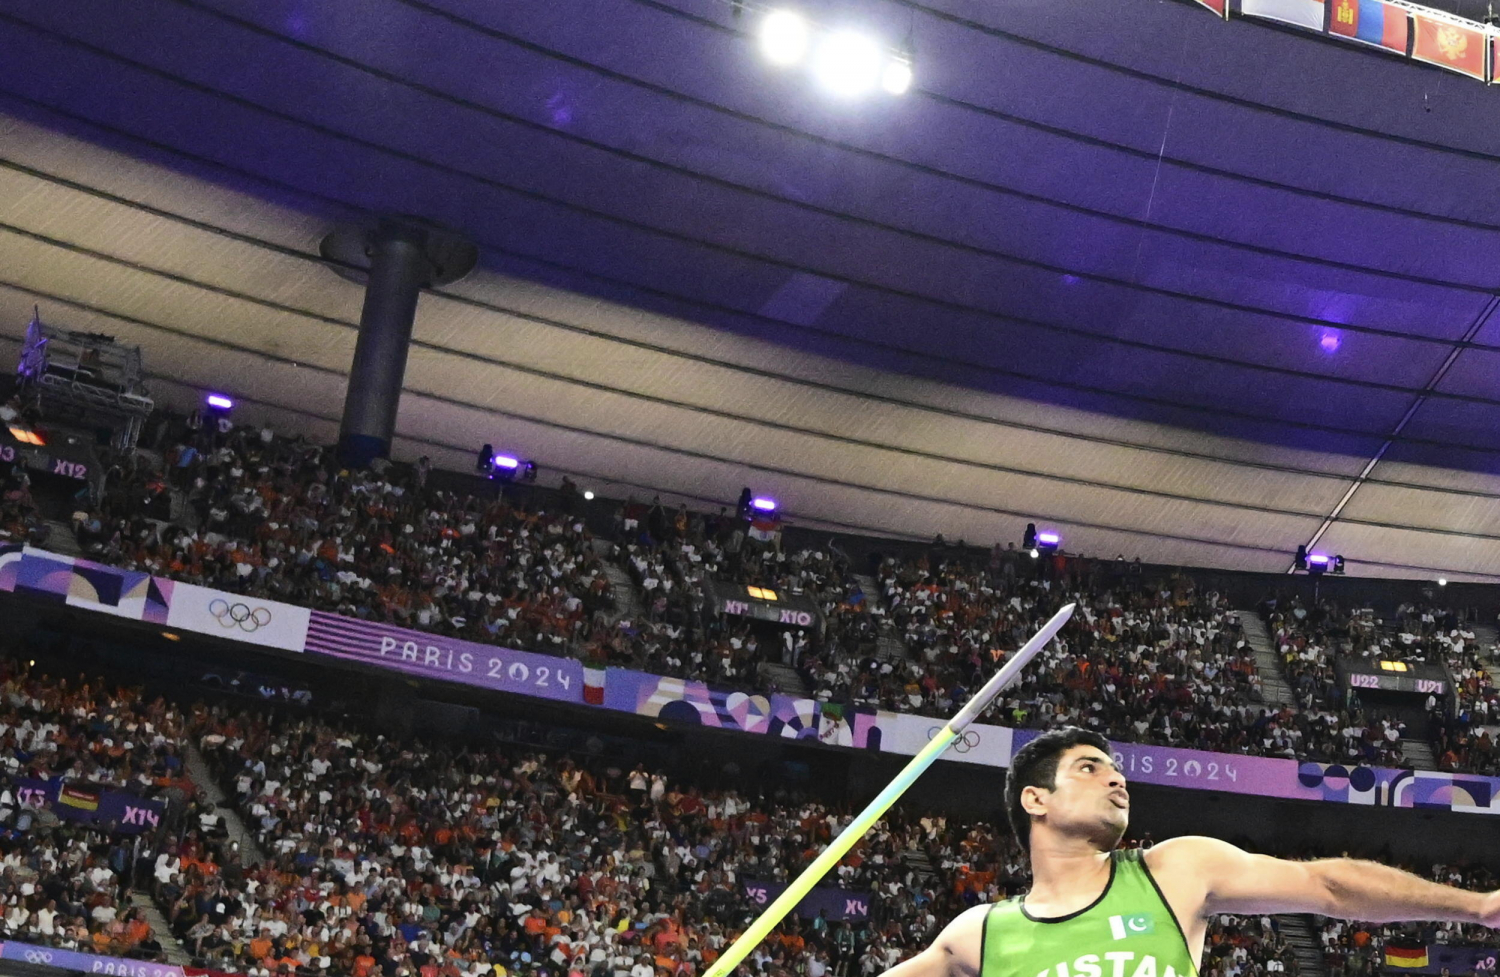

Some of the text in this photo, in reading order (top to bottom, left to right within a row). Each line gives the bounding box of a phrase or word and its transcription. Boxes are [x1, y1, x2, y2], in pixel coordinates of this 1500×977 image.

[54, 459, 86, 479] X12
[780, 610, 811, 626] X10
[381, 637, 570, 690] PARIS 2024
[1350, 673, 1379, 688] U22
[1417, 679, 1443, 694] U21
[1112, 752, 1237, 782] RIS 2024
[122, 805, 159, 827] X14
[845, 899, 867, 916] X4
